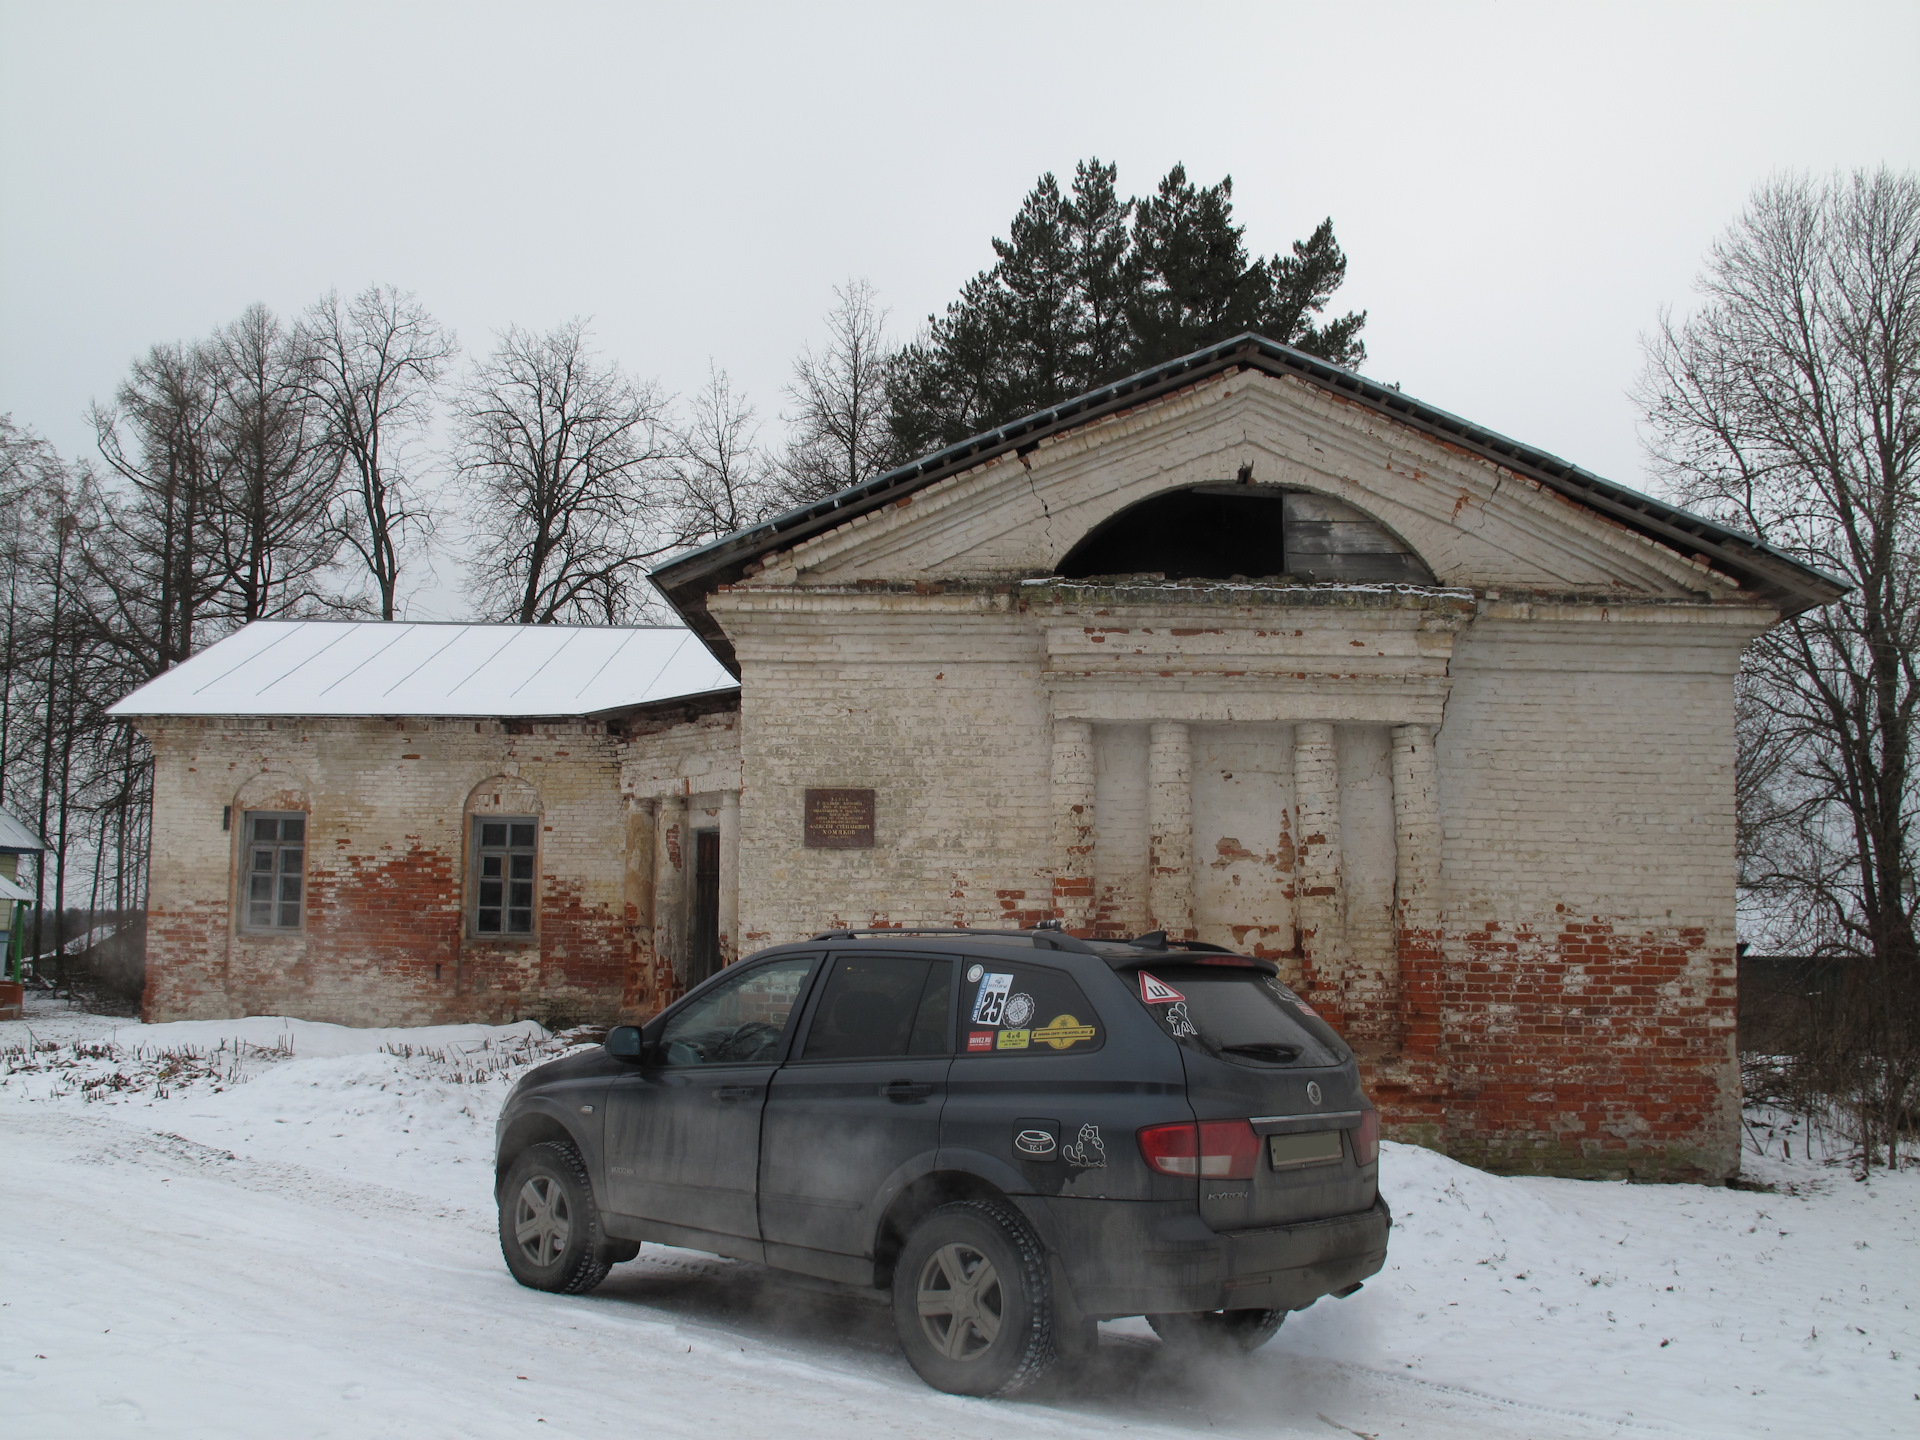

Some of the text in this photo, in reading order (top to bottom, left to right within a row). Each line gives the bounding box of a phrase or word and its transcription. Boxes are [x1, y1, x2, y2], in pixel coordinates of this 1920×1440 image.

[1148, 985, 1169, 997] Ш
[978, 991, 1006, 1023] 25
[969, 1036, 992, 1044] DRIVE2.RU
[1207, 1191, 1248, 1201] KYRON
